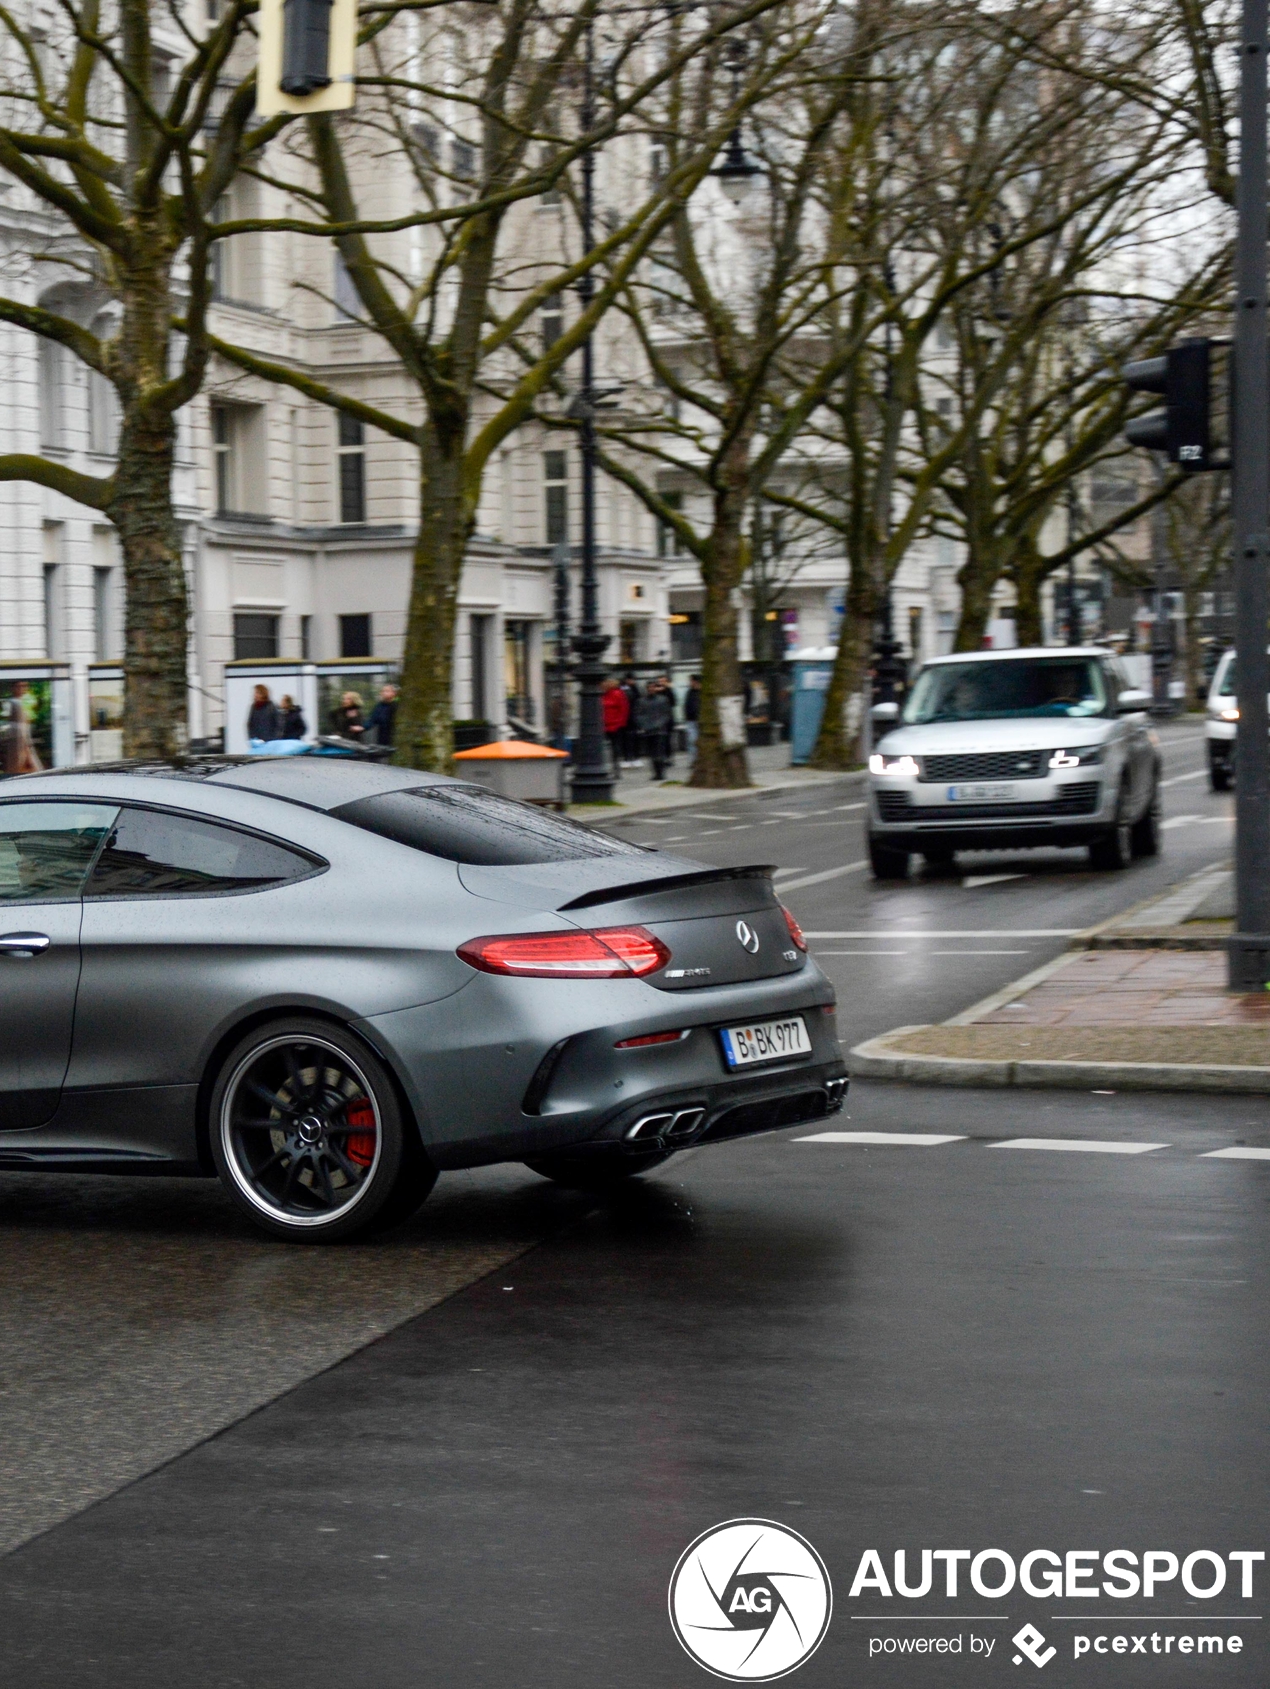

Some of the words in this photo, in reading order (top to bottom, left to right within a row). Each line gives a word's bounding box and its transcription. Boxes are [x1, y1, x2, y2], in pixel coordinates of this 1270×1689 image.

[736, 1031, 749, 1058] B
[754, 1026, 777, 1055] BK
[776, 1021, 801, 1051] 977
